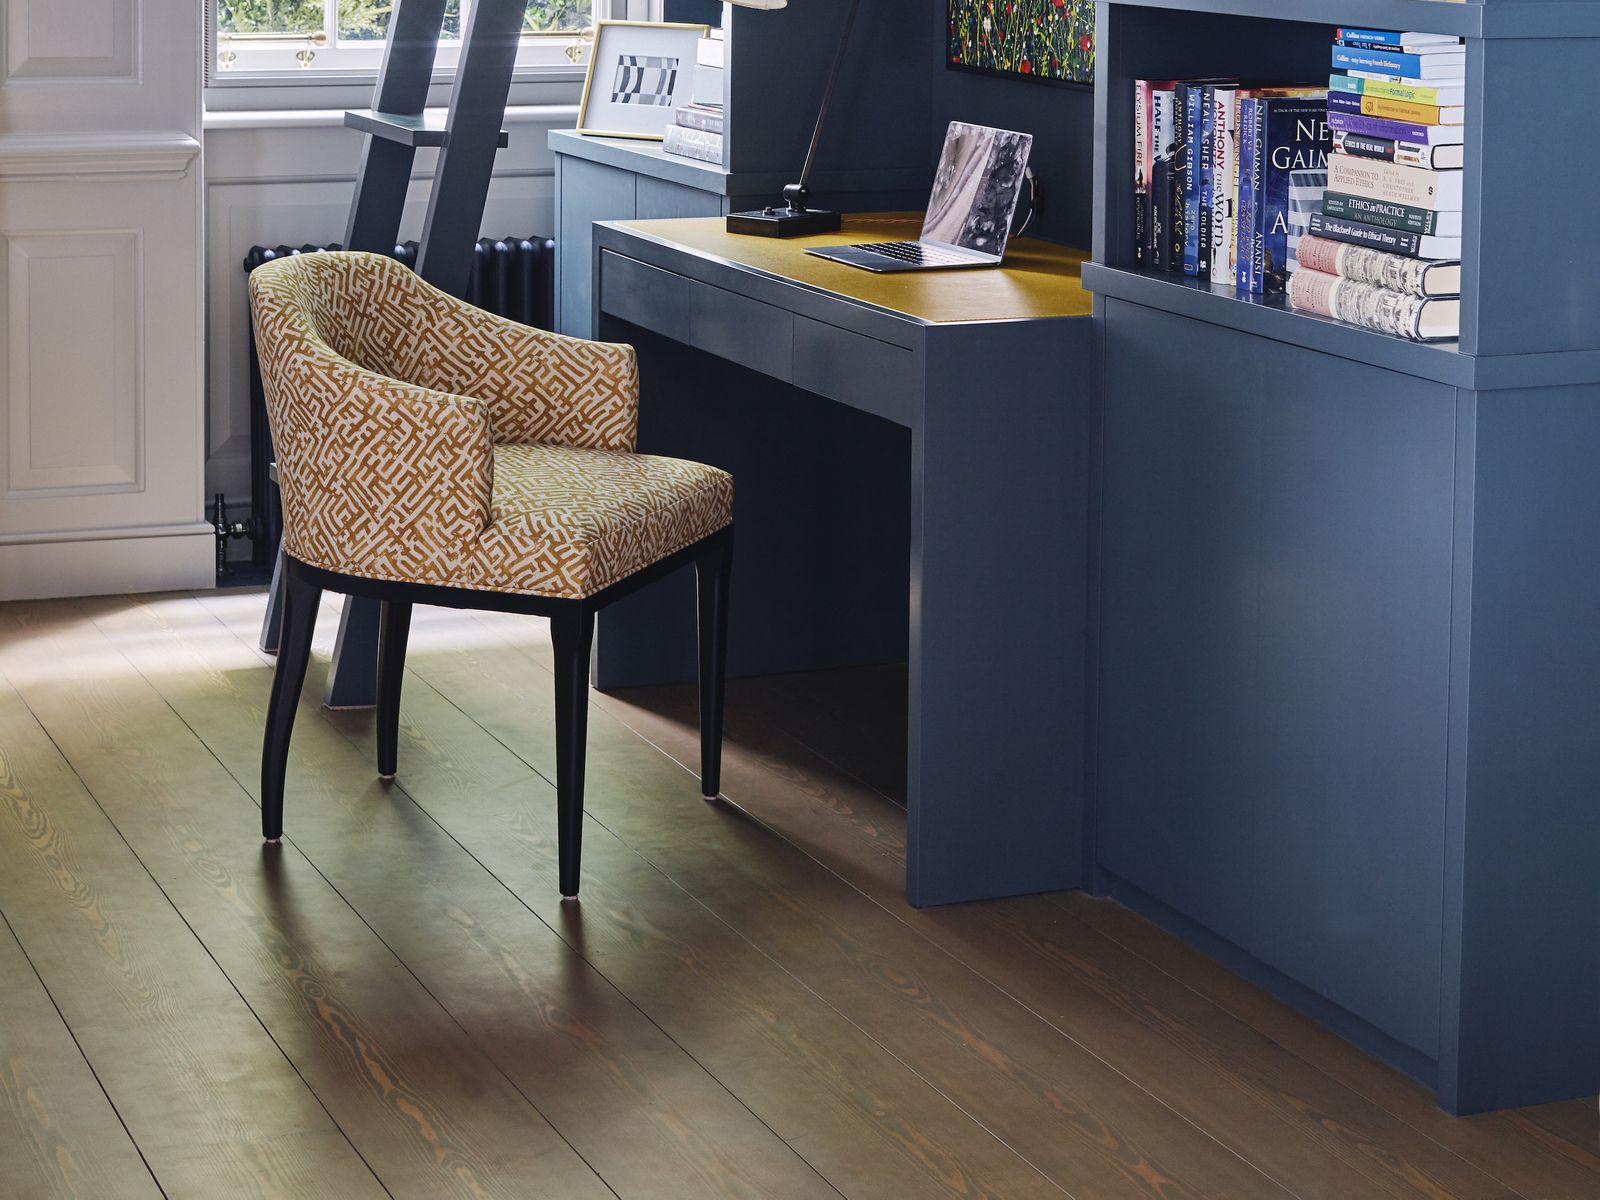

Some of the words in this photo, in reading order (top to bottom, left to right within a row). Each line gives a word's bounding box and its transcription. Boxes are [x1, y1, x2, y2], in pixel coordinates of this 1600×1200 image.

[1346, 31, 1359, 39] Collins
[1336, 54, 1349, 63] Collins
[1153, 95, 1161, 133] HALF
[1187, 94, 1195, 144] WILLIAM
[1202, 92, 1210, 124] NEAL
[1255, 104, 1263, 132] NEIL
[1216, 101, 1225, 170] ANTHONY
[1296, 119, 1329, 141] NE
[1153, 135, 1161, 153] THE
[1201, 129, 1210, 170] ASHER
[1344, 140, 1356, 149] ETHICS
[1366, 142, 1374, 151] REAL
[1374, 143, 1385, 153] WORLD
[1254, 138, 1263, 191] GAIMAN
[1334, 165, 1339, 173] A
[1339, 165, 1371, 179] COMPANION
[1371, 172, 1379, 180] TO
[1334, 174, 1355, 185] APPLIED
[1355, 177, 1375, 189] ETHICS
[1348, 199, 1370, 211] ETHICS
[1370, 203, 1376, 212] in
[1375, 203, 1405, 218] PRACTICE
[1353, 212, 1362, 220] AN
[1363, 215, 1398, 227] ANTHOLOGY
[1325, 222, 1333, 231] The
[1333, 223, 1351, 236] Blackwell
[1351, 227, 1363, 237] Guide
[1368, 230, 1381, 242] Ethical
[1381, 233, 1397, 246] Theory
[1254, 231, 1263, 275] ANANSI
